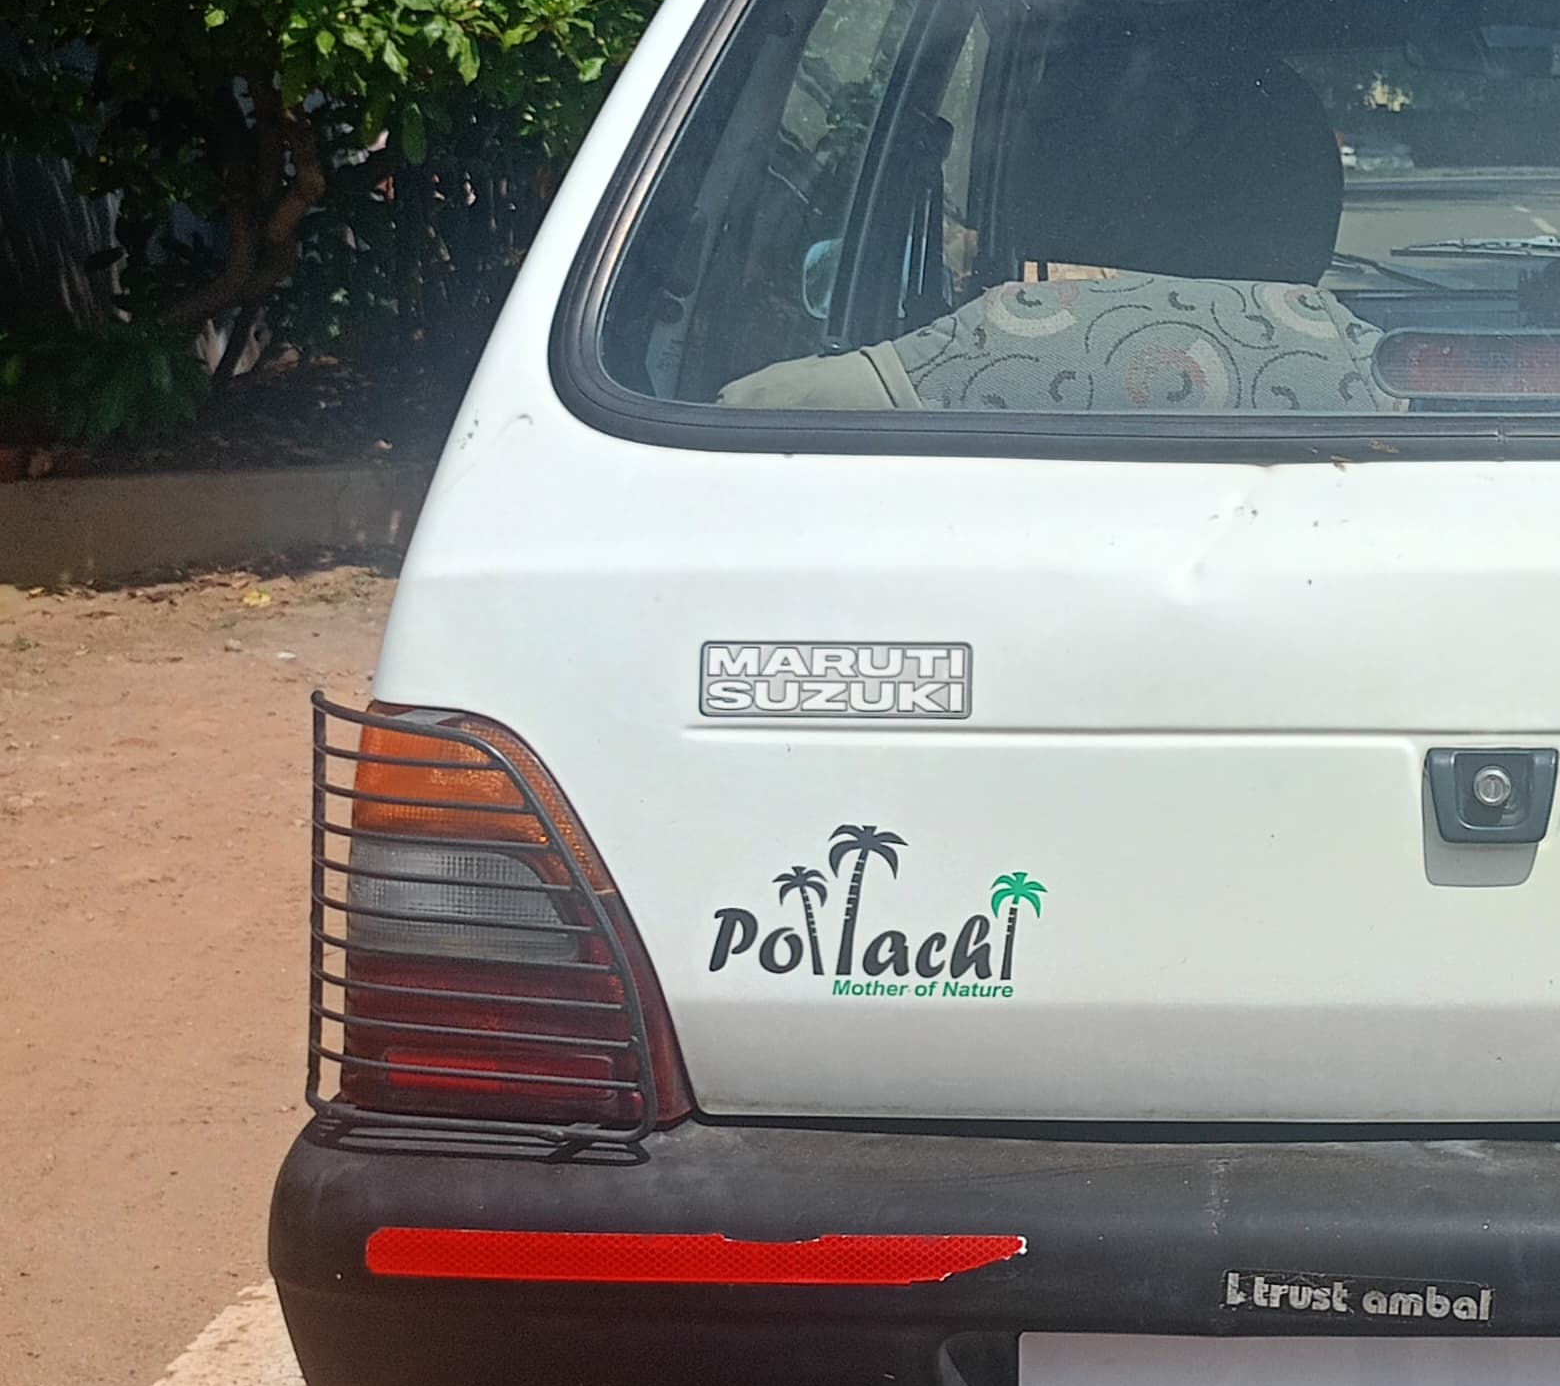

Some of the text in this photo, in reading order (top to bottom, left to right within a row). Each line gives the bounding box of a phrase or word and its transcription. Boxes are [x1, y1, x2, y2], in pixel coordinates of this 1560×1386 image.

[707, 646, 965, 679] MARUTI
[706, 679, 965, 713] SUZUKI
[709, 824, 1047, 981] Pollachi
[832, 979, 1014, 998] Mother of Nature
[1253, 1276, 1350, 1312] trust
[1362, 1285, 1494, 1321] ambal
